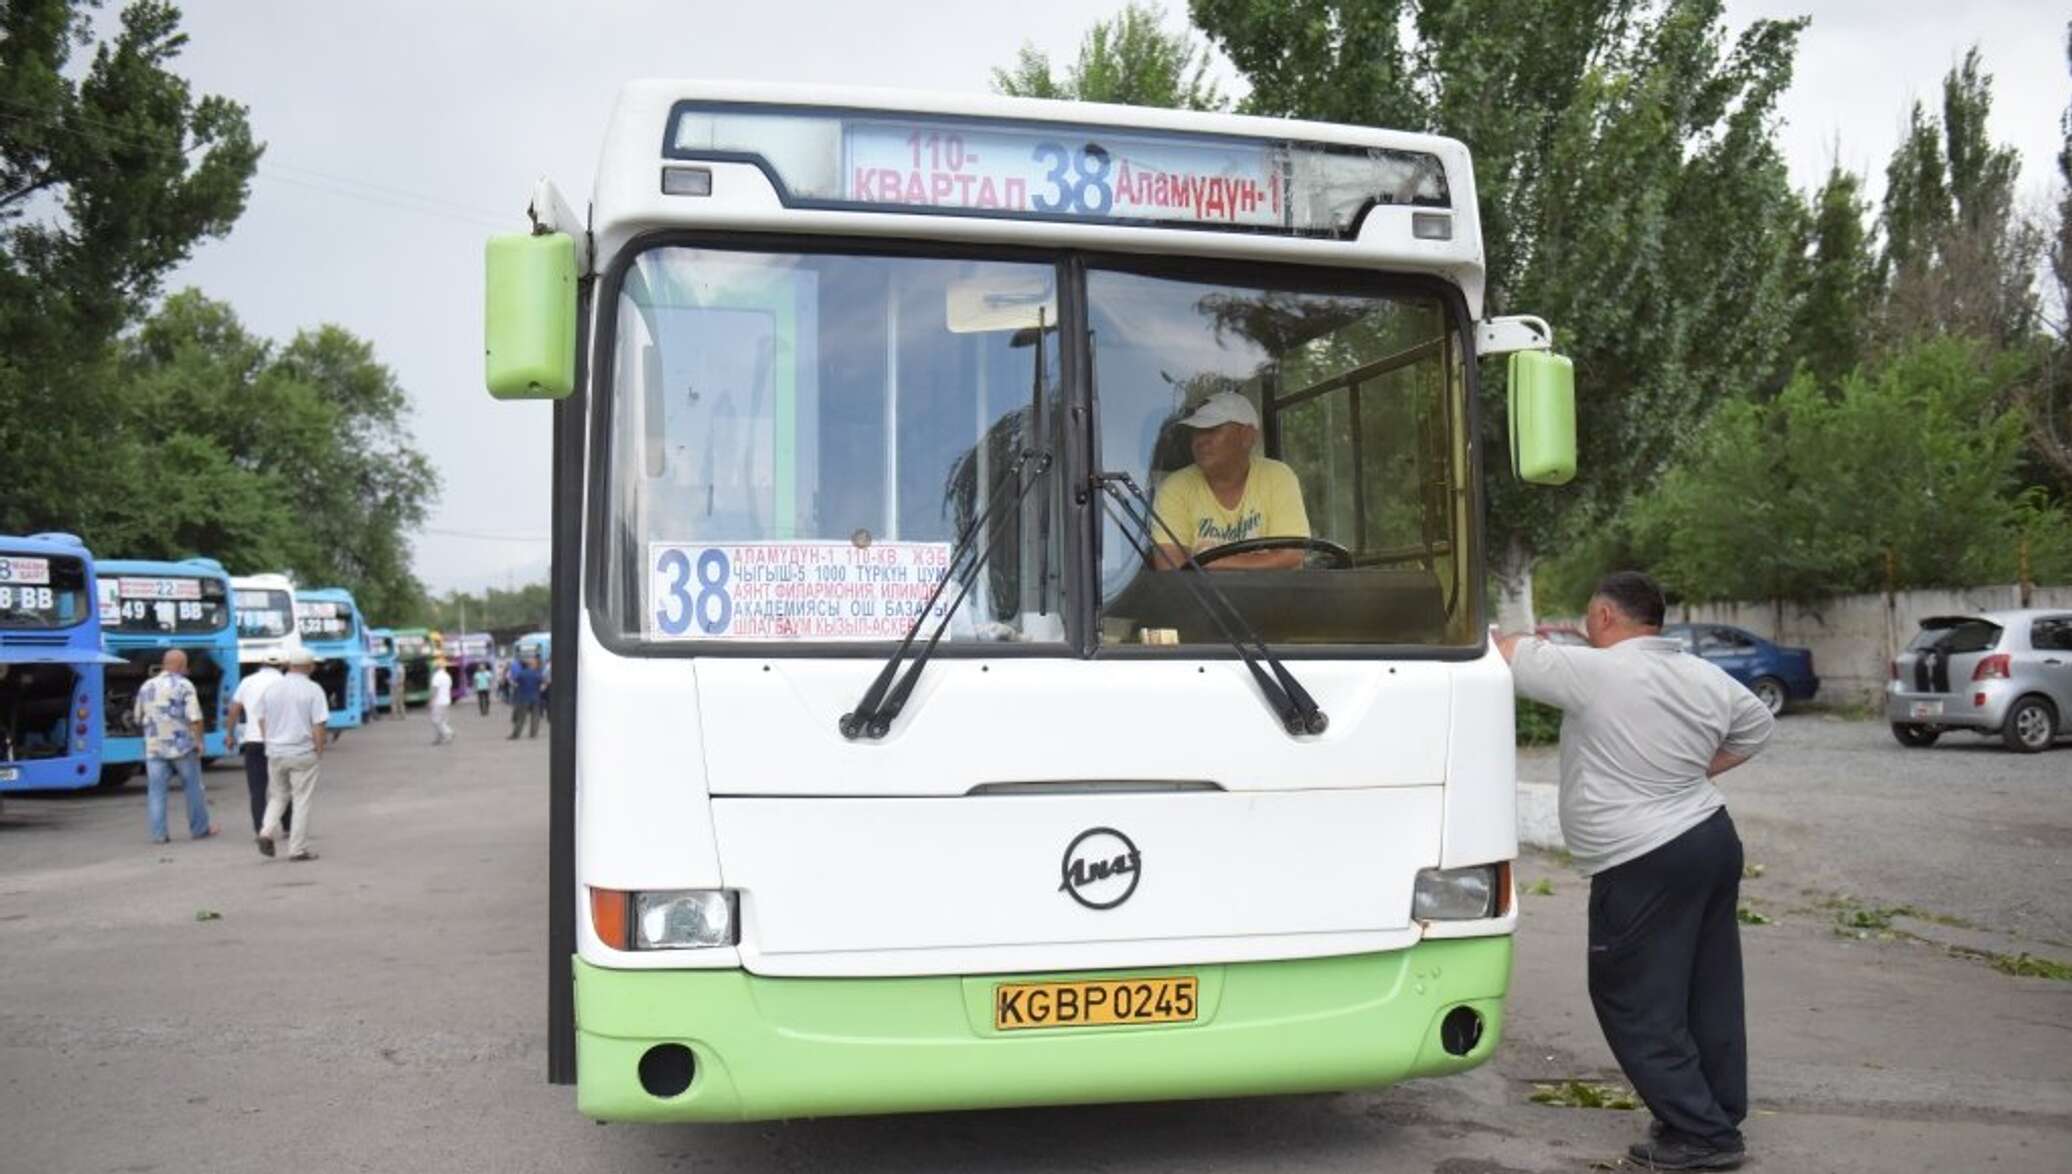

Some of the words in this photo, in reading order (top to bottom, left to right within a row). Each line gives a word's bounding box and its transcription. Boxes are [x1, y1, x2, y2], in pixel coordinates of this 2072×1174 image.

[1031, 139, 1113, 216] 38
[657, 548, 732, 634] 38
[850, 600, 874, 617] ОШ
